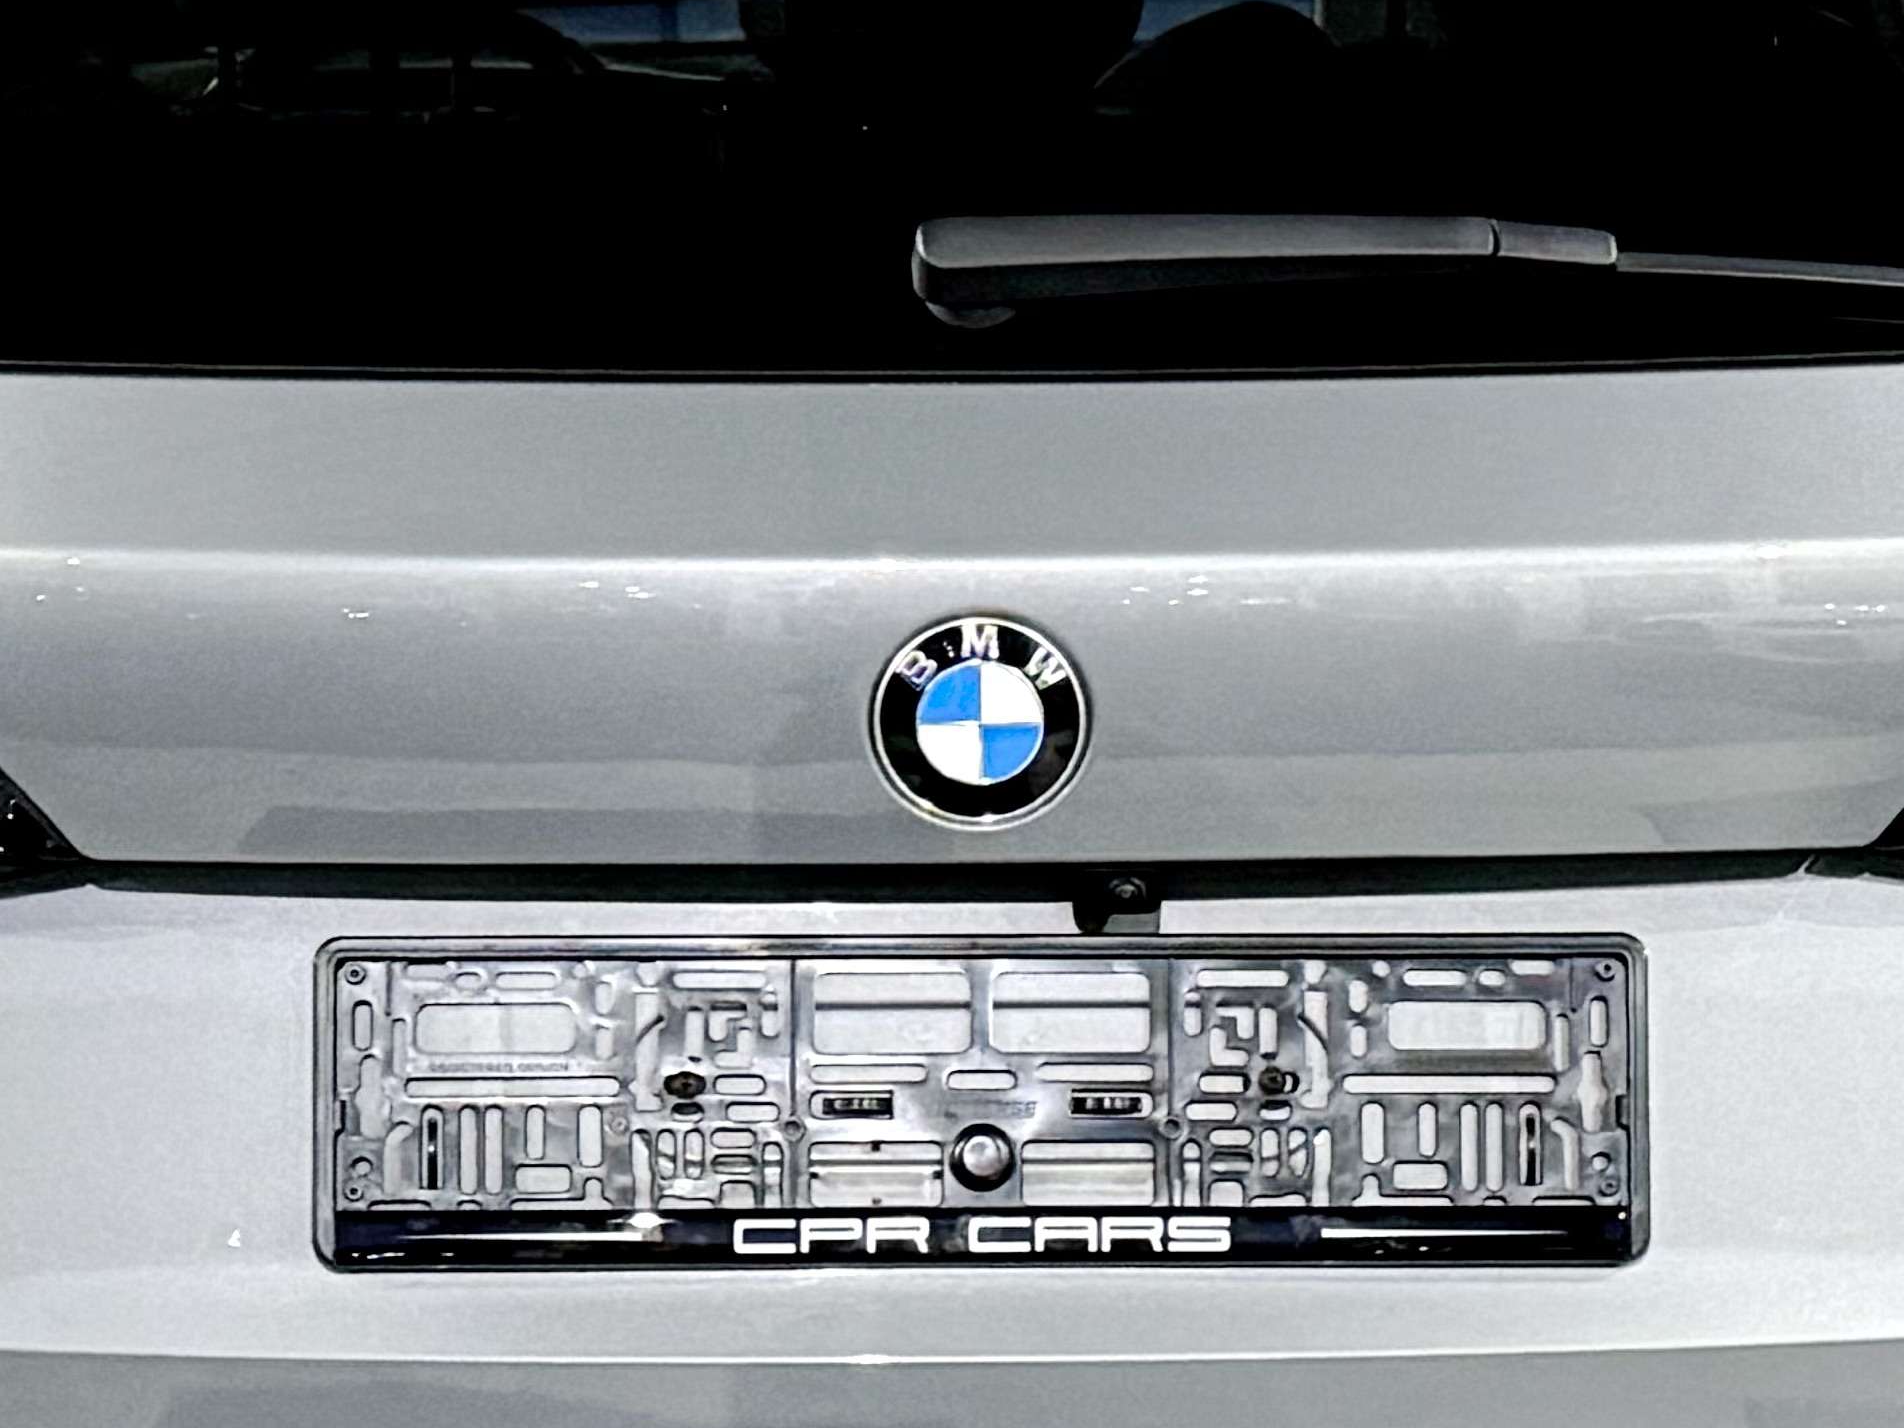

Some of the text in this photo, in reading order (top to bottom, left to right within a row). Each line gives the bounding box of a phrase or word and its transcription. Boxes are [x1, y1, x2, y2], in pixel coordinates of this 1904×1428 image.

[894, 622, 1070, 692] BMW
[732, 1216, 1233, 1256] CPR CARS
